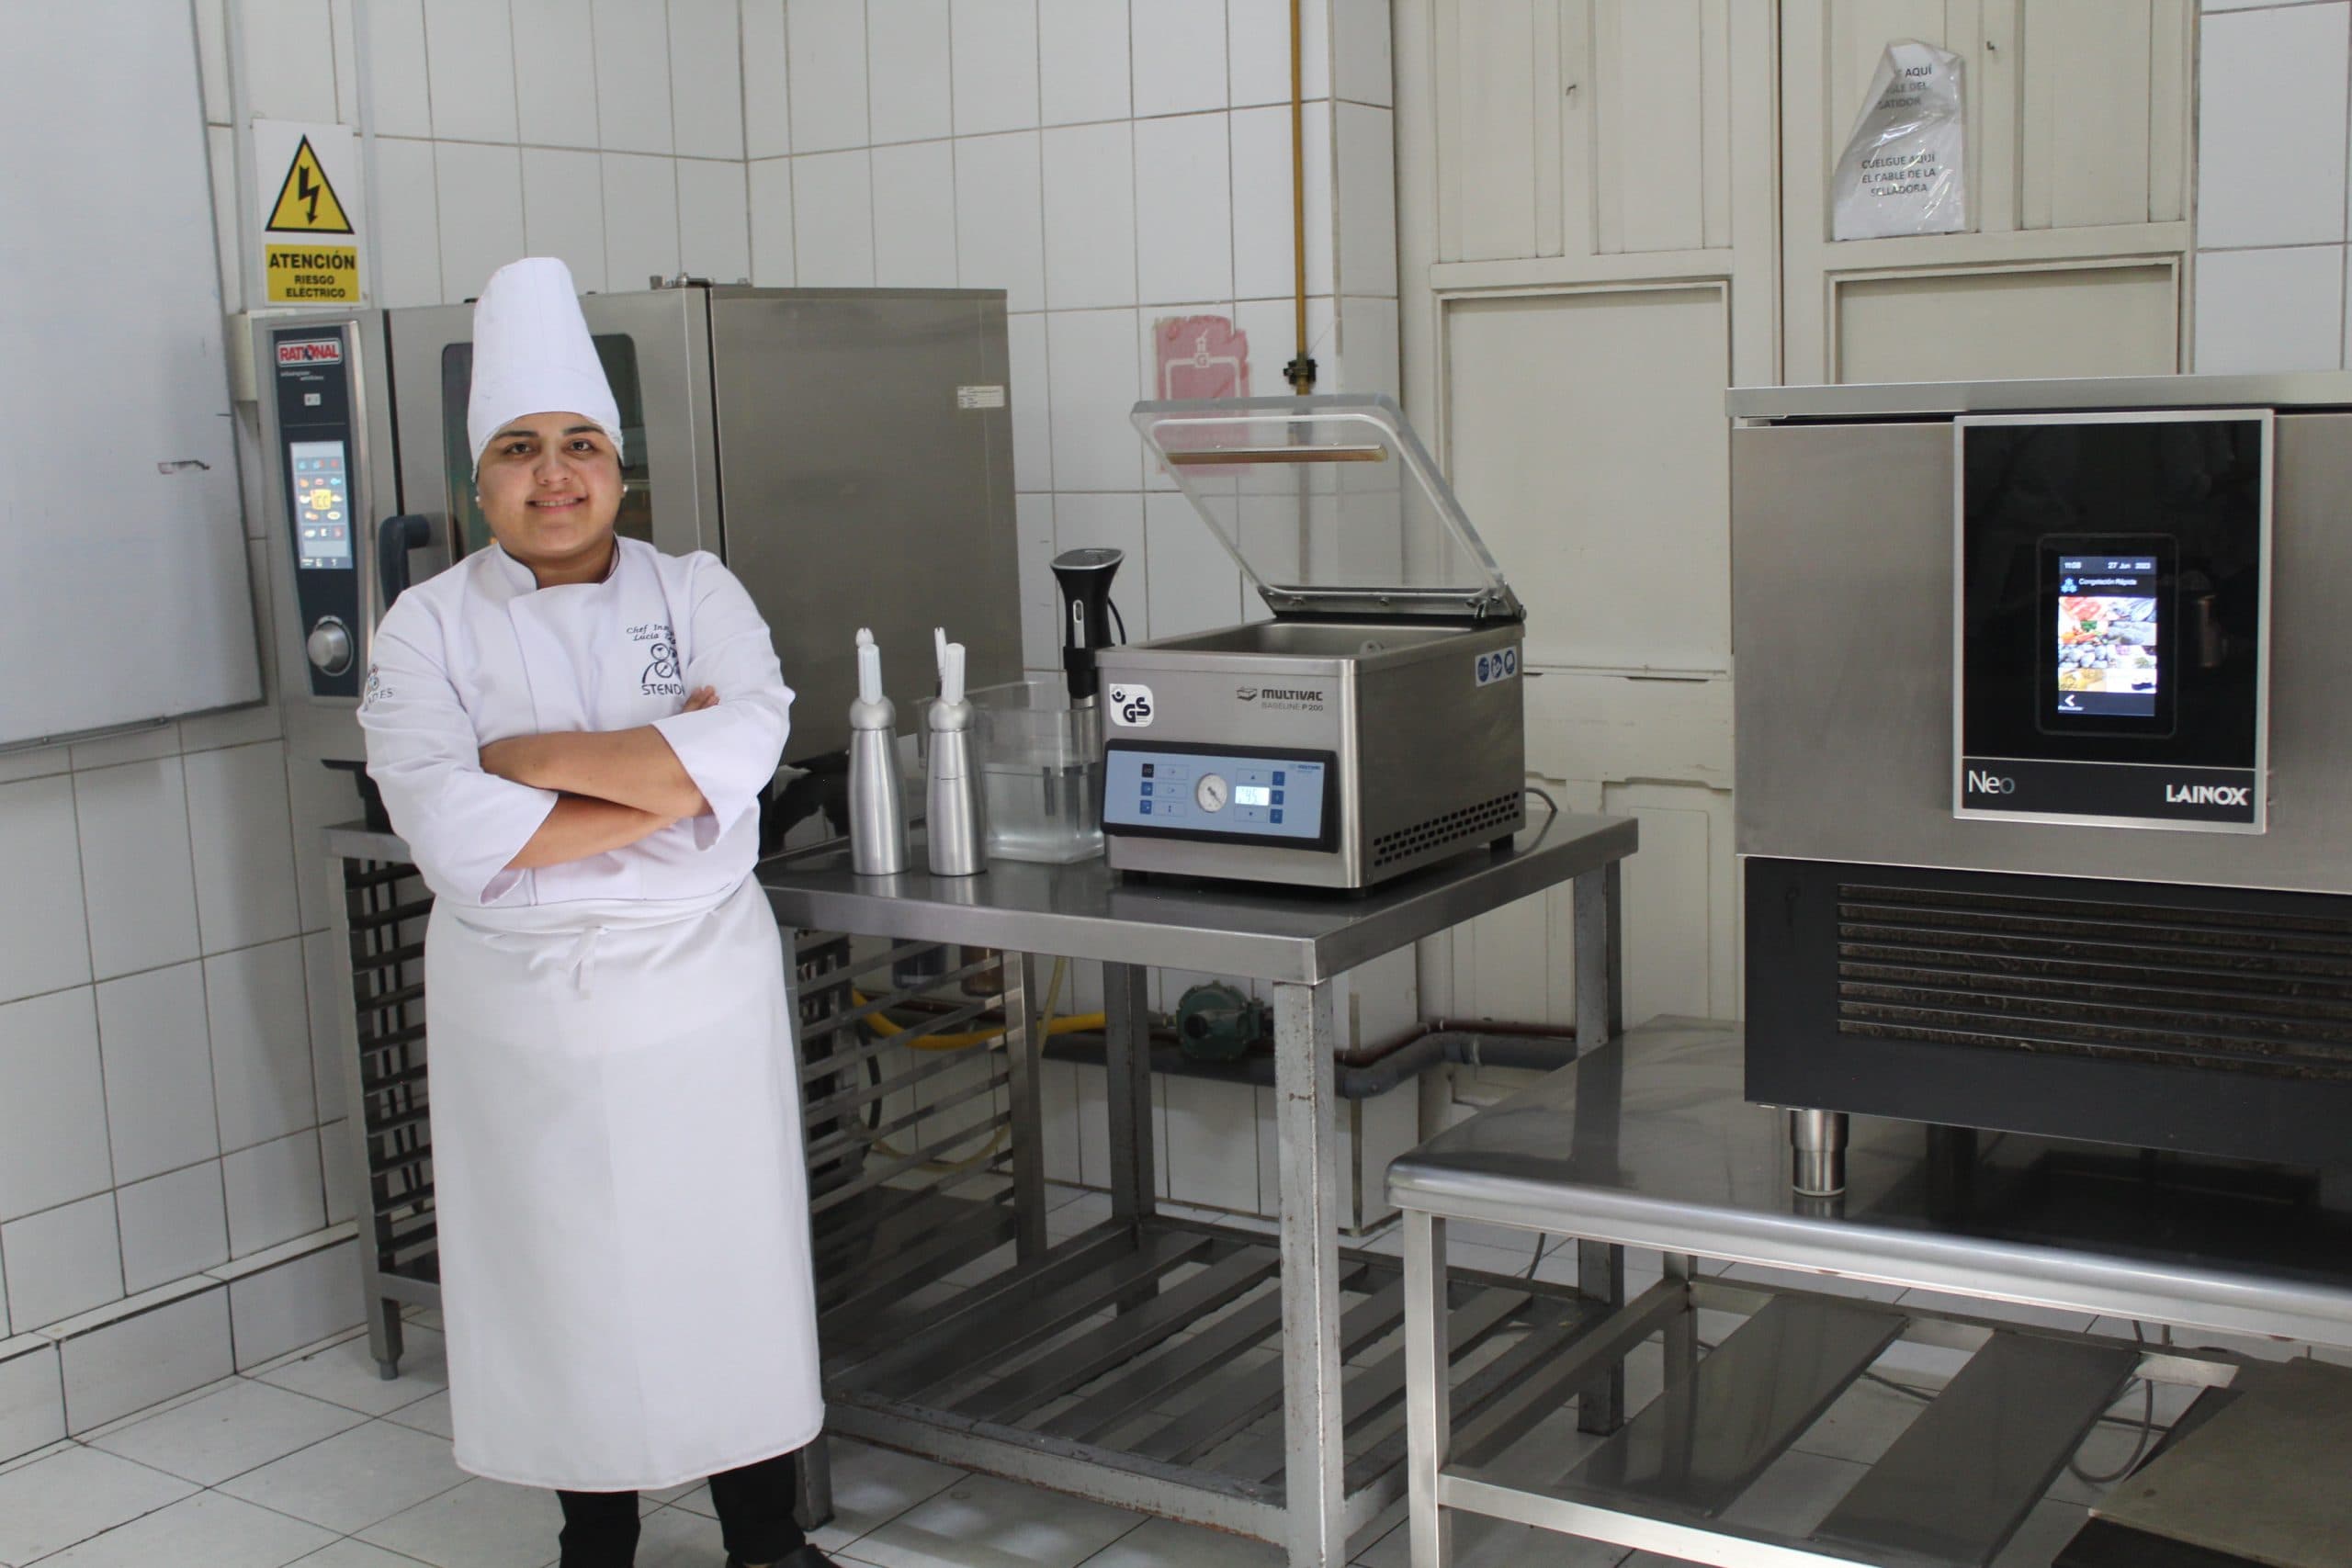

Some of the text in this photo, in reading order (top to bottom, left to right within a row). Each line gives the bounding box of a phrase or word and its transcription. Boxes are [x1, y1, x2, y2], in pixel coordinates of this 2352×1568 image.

[1861, 156, 1906, 169] CUELGUE
[1861, 168, 1936, 183] EL CABLE DE LA
[269, 250, 356, 270] ATENCIÓN
[294, 275, 334, 286] RIESGO
[627, 625, 648, 634] Chef
[1261, 689, 1323, 701] MULTIVAC
[1123, 696, 1151, 723] GS
[1968, 770, 2015, 794] Neo
[2165, 784, 2251, 806] LAINOX
